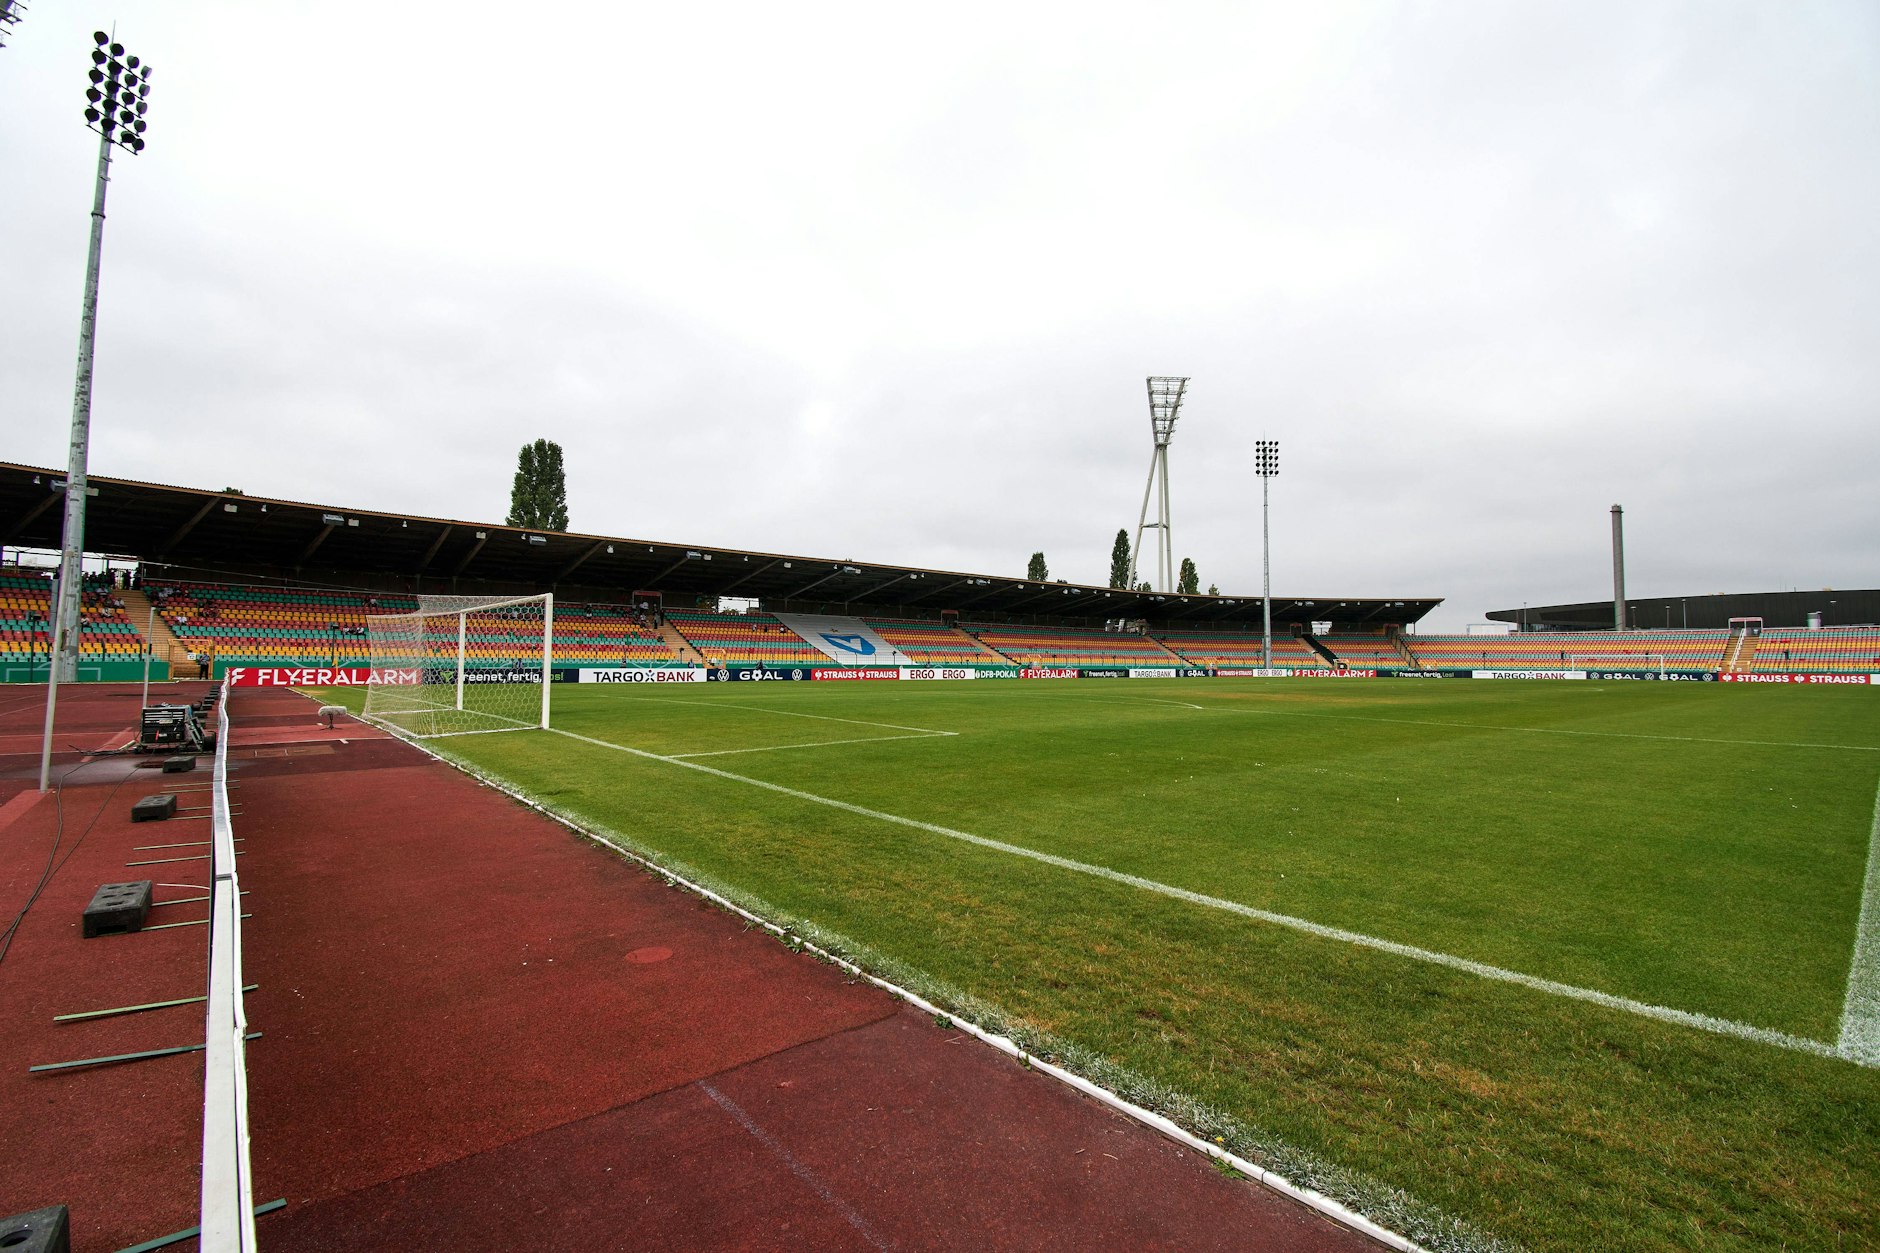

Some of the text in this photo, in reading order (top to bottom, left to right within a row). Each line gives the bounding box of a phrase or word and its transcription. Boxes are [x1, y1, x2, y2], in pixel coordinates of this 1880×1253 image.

[258, 668, 417, 685] FLYERALARM
[463, 672, 506, 683] reenet,
[823, 671, 898, 679] STRAUSS STRAUSS
[910, 669, 966, 679] ERGO ERGO
[980, 670, 1017, 678] DFB-POKAL
[1028, 670, 1077, 678] FLYERALARM
[1302, 670, 1366, 678] FLYERALARM
[1737, 674, 1866, 684] STRAUSS STRAUSS
